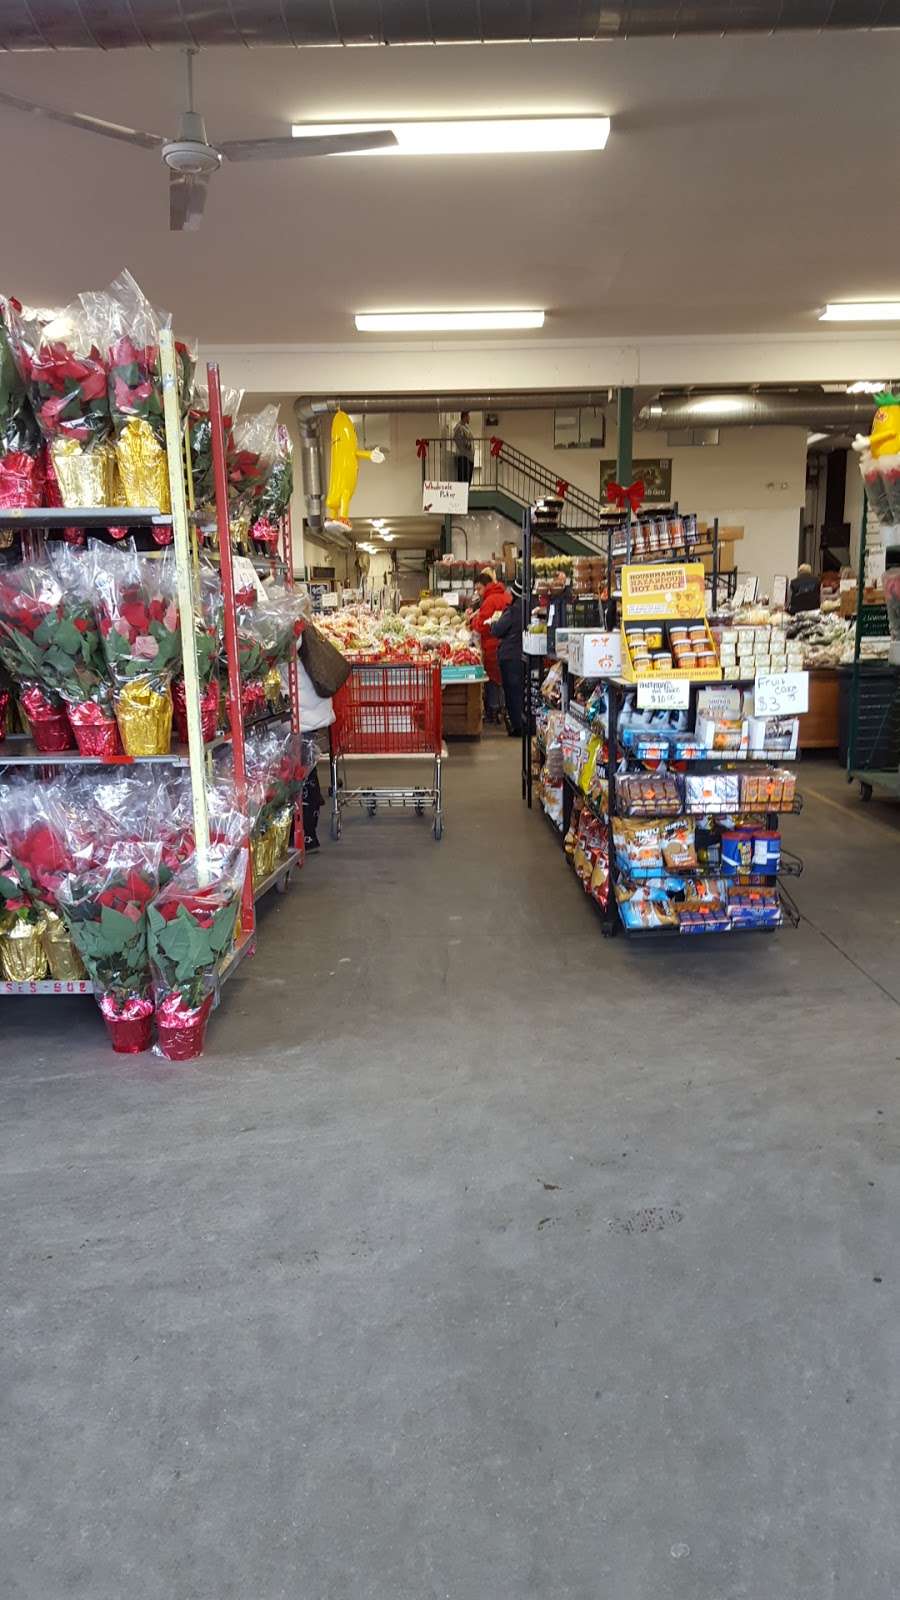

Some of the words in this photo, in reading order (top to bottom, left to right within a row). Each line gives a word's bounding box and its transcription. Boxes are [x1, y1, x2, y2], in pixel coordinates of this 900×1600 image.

[424, 481, 452, 490] Wholesale
[631, 584, 650, 594] HOT
[653, 581, 684, 592] SAUCE
[757, 676, 786, 689] Fruit
